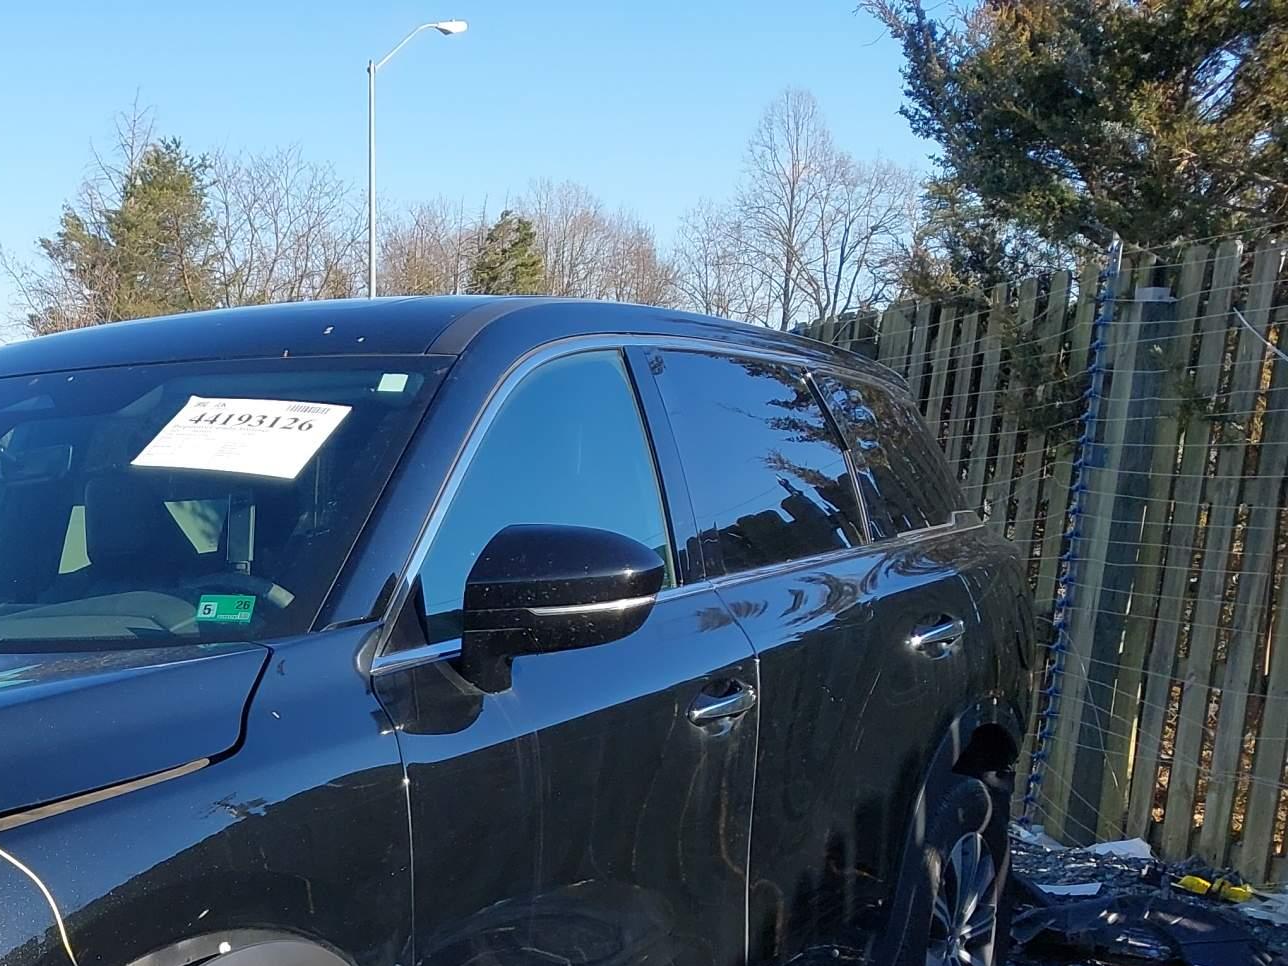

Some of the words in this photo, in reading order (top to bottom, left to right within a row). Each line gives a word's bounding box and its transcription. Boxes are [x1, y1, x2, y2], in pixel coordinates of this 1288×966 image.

[189, 411, 314, 432] 44193126
[202, 603, 213, 616] 5
[235, 600, 251, 610] 26
